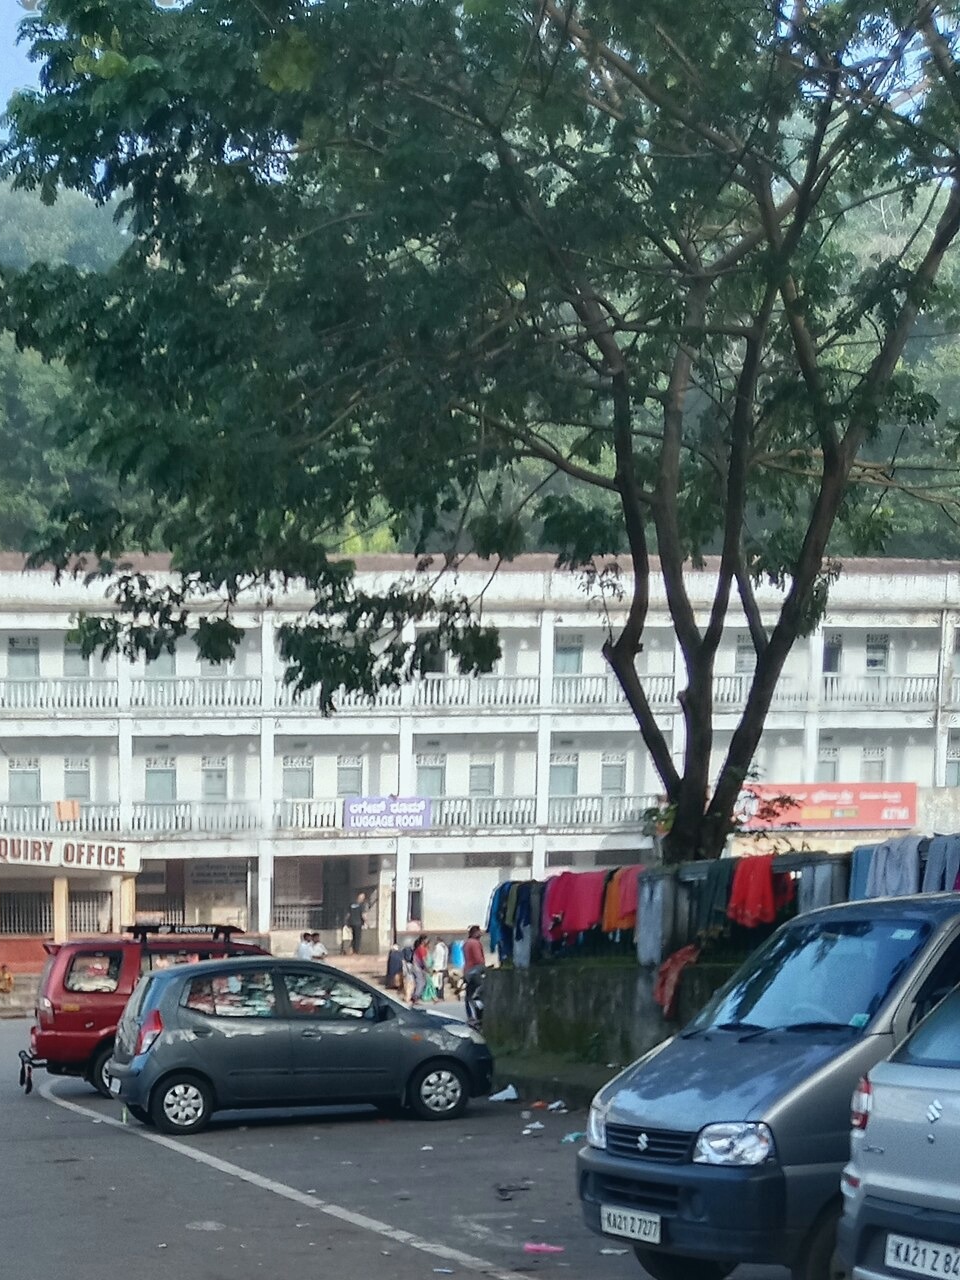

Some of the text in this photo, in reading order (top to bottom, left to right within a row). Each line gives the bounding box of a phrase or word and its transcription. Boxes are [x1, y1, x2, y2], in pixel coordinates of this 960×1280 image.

[350, 814, 423, 828] LUGGAGE ROOM
[63, 842, 126, 868] OFFICE
